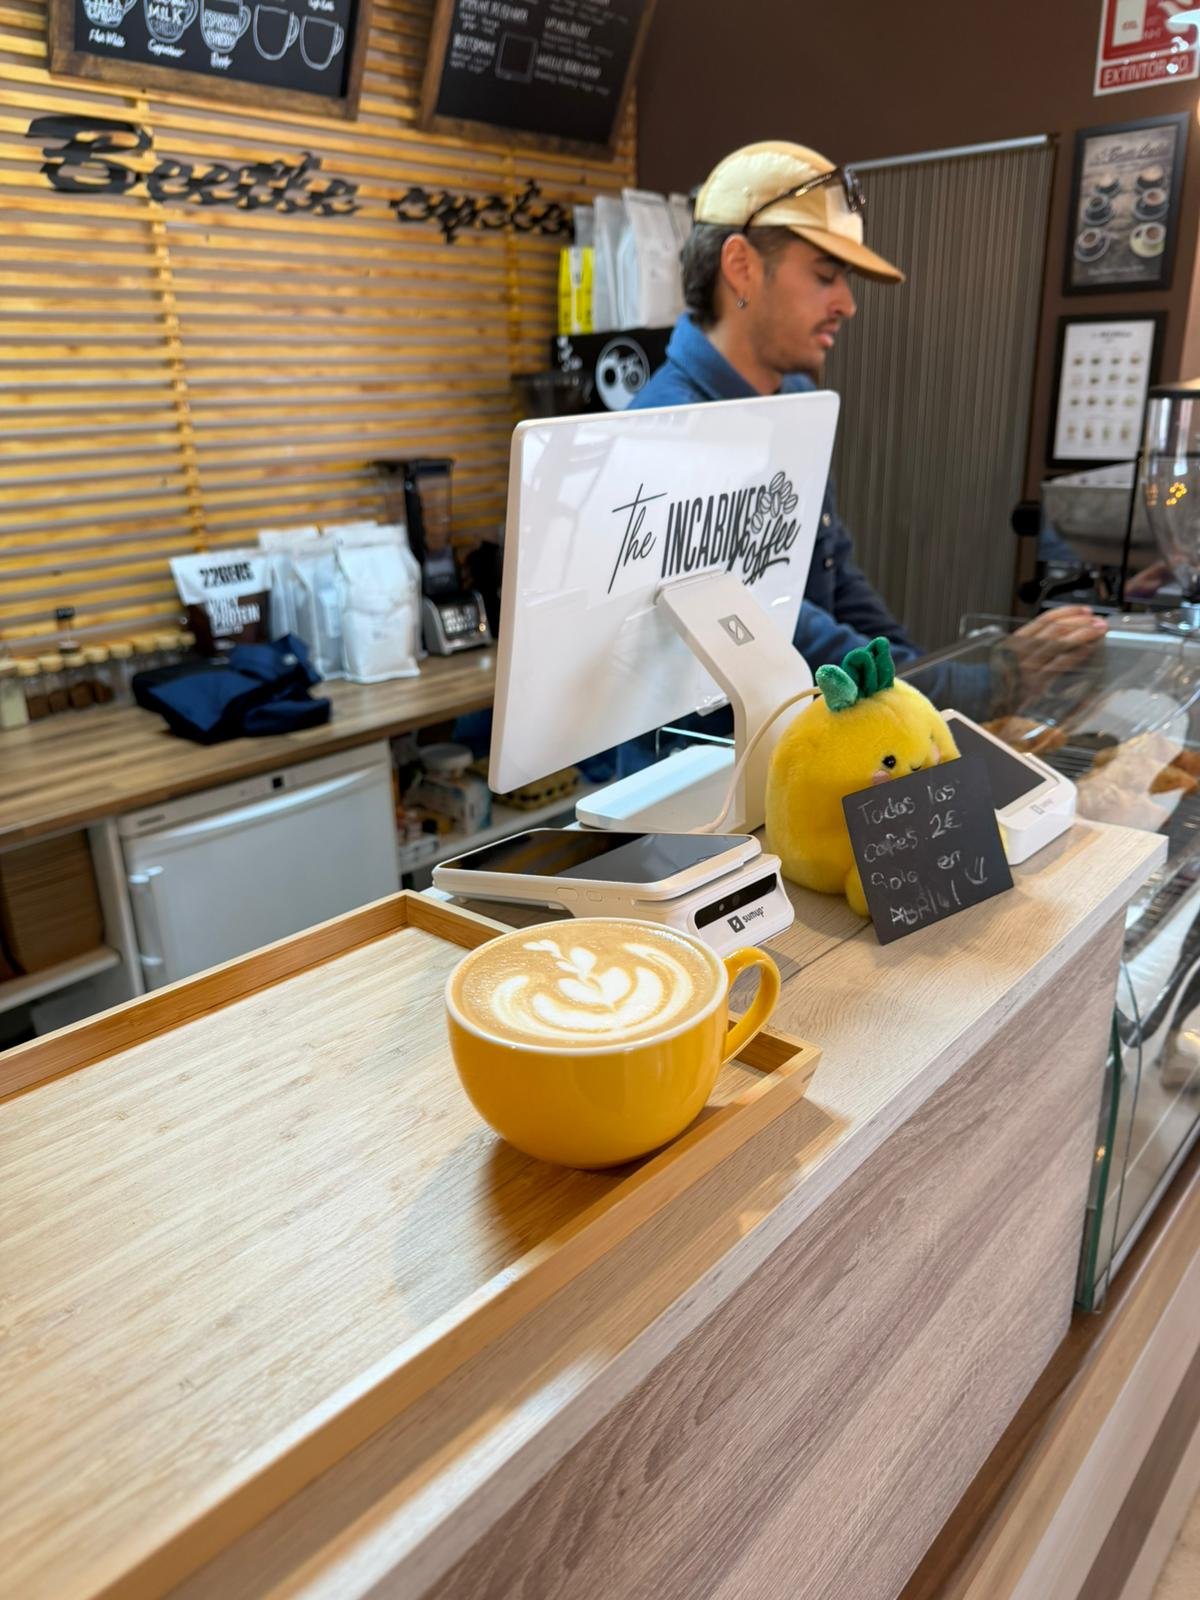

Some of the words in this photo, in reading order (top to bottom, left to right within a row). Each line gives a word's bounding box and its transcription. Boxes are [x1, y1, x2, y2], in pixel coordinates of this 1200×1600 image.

[1103, 60, 1165, 86] EXTINTOR
[926, 784, 957, 805] los
[937, 850, 961, 869] en
